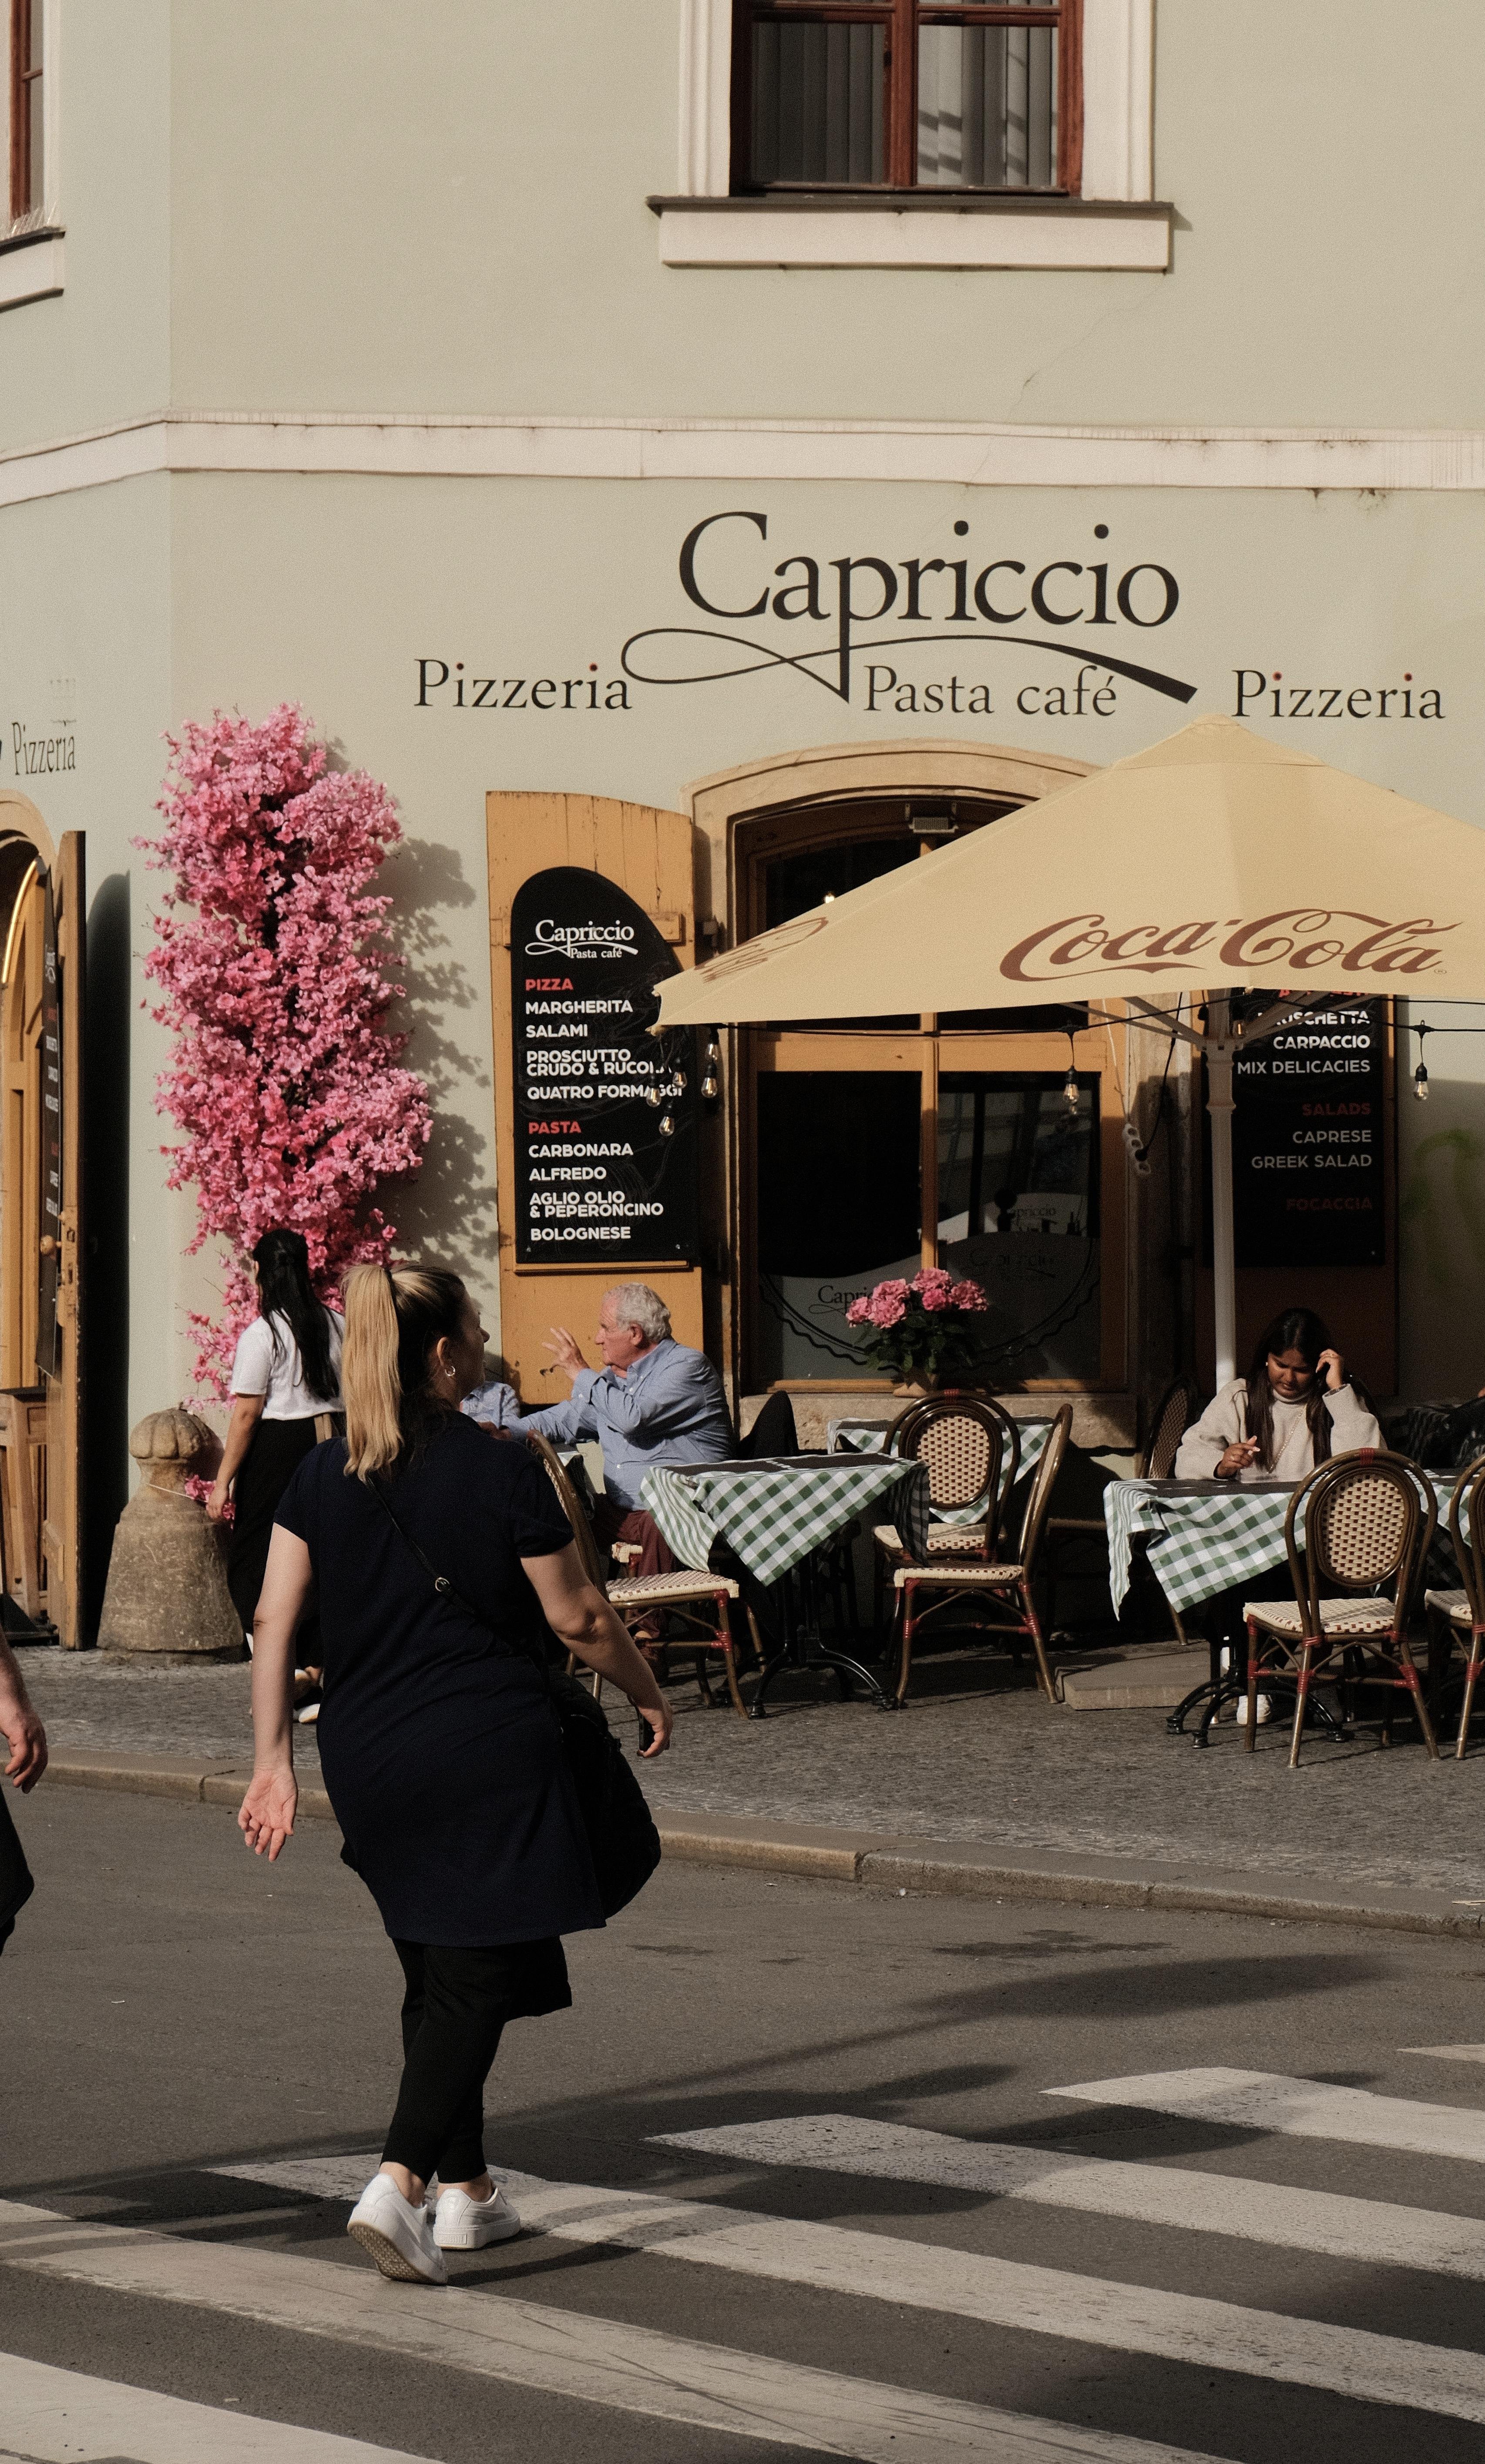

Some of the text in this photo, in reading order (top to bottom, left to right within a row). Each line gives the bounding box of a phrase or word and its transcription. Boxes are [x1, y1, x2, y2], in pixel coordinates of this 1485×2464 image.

[680, 512, 1179, 703] Capriccio
[414, 659, 632, 709] Pizzeria
[867, 665, 1117, 716] Pasta café
[1232, 669, 1446, 719] Pizzeria
[12, 722, 76, 775] Pizzeria
[535, 919, 635, 957] Capriccio
[571, 947, 622, 958] Pasta café
[526, 978, 574, 991] PIZZA
[526, 1000, 633, 1014] MARGHERITA
[526, 1024, 588, 1038] SALAMI
[1273, 1035, 1371, 1049] CARPACCIO
[527, 1049, 631, 1063] PROSCIUTTO
[527, 1063, 584, 1076] CRUDO
[588, 1063, 599, 1075] &
[1238, 1060, 1371, 1074] MIX DELICACIES
[527, 1086, 594, 1099] QUATRO
[1302, 1103, 1371, 1116] SALADS
[529, 1121, 581, 1134] PASTA
[1293, 1130, 1371, 1143] CAPRESE
[529, 1143, 633, 1158] CARBONARA
[1252, 1155, 1372, 1168] GREEK SALAD
[529, 1166, 607, 1181] ALFREDO
[530, 1191, 625, 1205] AGLIO OLIO
[1287, 1197, 1372, 1210] FOCACCIA
[530, 1203, 664, 1218] & PEPERONCINO
[531, 1227, 631, 1241] BOLOGNESE
